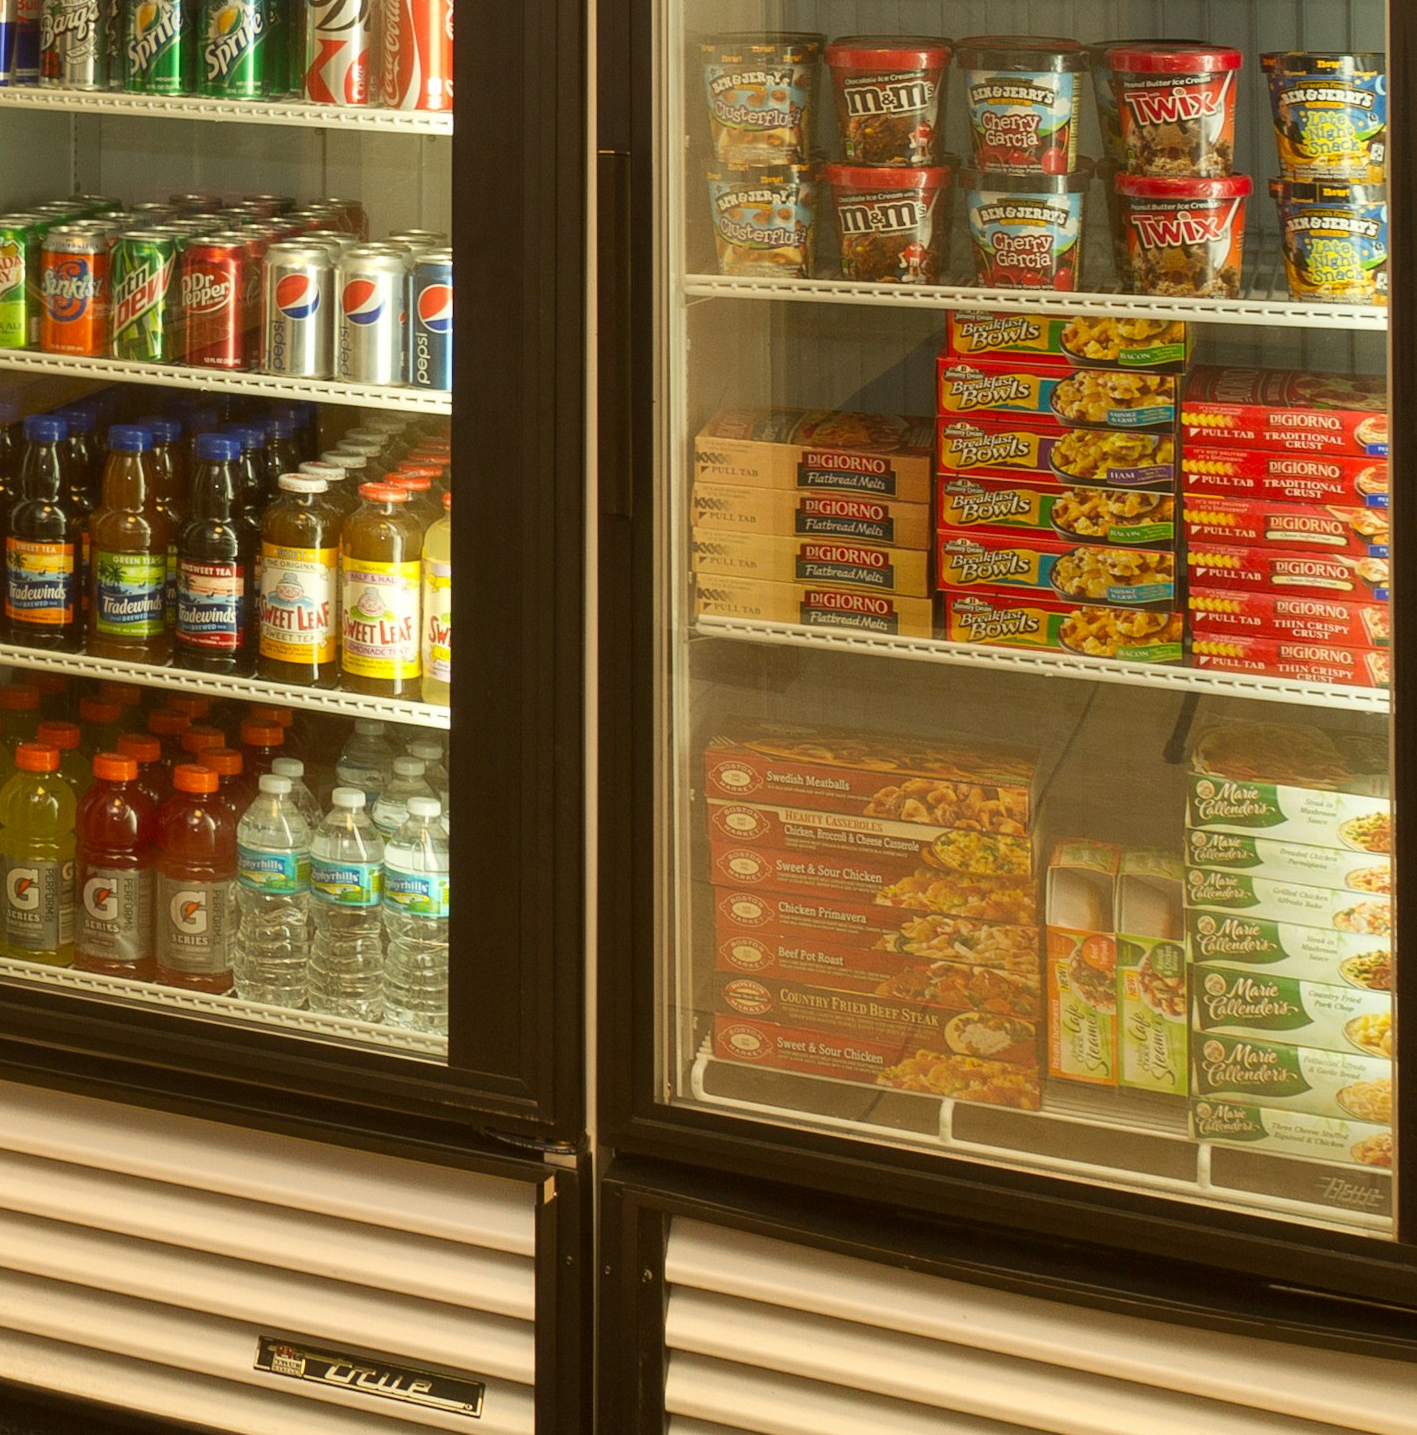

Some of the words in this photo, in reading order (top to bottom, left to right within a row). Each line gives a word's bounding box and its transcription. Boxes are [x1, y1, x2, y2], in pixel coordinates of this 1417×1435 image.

[128, 9, 184, 75] Sprite
[205, 13, 264, 82] Sprite
[1124, 80, 1148, 88] Peanut
[1149, 79, 1172, 88] Butter
[1172, 78, 1185, 86] Ice
[1185, 77, 1211, 85] Cream
[972, 89, 995, 102] BEN
[1003, 87, 1055, 105] JERRY'S
[982, 114, 1040, 132] Cherry
[1307, 112, 1347, 127] Late
[986, 129, 1039, 148] Garcia
[1307, 126, 1355, 143] Night
[1308, 139, 1360, 155] Snack
[993, 233, 1052, 252] Cherry
[996, 250, 1051, 268] Garcia
[41, 269, 103, 300] Sunkist
[193, 272, 214, 288] Dr
[181, 283, 230, 308] Pepper
[415, 331, 431, 385] pepsi
[1120, 351, 1151, 361] BACON
[951, 375, 1014, 396] Breakfast
[961, 381, 1030, 409] Bowls
[1202, 429, 1229, 438] PULL
[1233, 430, 1255, 439] TAB
[1263, 432, 1345, 445] TRADITIONAL
[1285, 441, 1324, 450] CRUST
[807, 471, 858, 486] Flatbread
[858, 477, 886, 490] Melts
[1110, 471, 1135, 480] HAM
[805, 519, 855, 532] Flatbread
[856, 523, 884, 537] Melts
[112, 554, 140, 565] GREEN
[142, 555, 157, 565] TEA
[8, 581, 66, 600] Tradewinds
[102, 595, 162, 615] Tradewinds
[342, 619, 378, 644] SWEET
[379, 615, 413, 645] LEAF
[1273, 620, 1304, 629] THIN
[1306, 622, 1350, 635] CRISPY
[1292, 629, 1331, 640] CRUST
[766, 771, 804, 785] Swedish
[805, 776, 850, 791] Meatballs
[1212, 783, 1260, 803] Marie
[785, 810, 823, 824] HEARTY
[826, 816, 883, 832] CASSEROLES
[776, 860, 805, 874] Sweet
[808, 865, 816, 875] &
[817, 865, 840, 877] Sour
[842, 869, 882, 884] Chicken
[778, 901, 816, 915] Chicken
[818, 907, 867, 924] Primavera
[171, 933, 209, 947] SERIES
[778, 947, 799, 959] Beef
[800, 950, 816, 962] Pot
[817, 953, 844, 966] Roast
[1226, 978, 1279, 1002] Marie
[780, 988, 830, 1009] COUNTRY
[831, 997, 867, 1014] FRIED
[869, 1003, 899, 1020] BEEF
[901, 1009, 939, 1026] STEAK
[1204, 994, 1298, 1020] Callender's
[1202, 1060, 1298, 1086] Callender's
